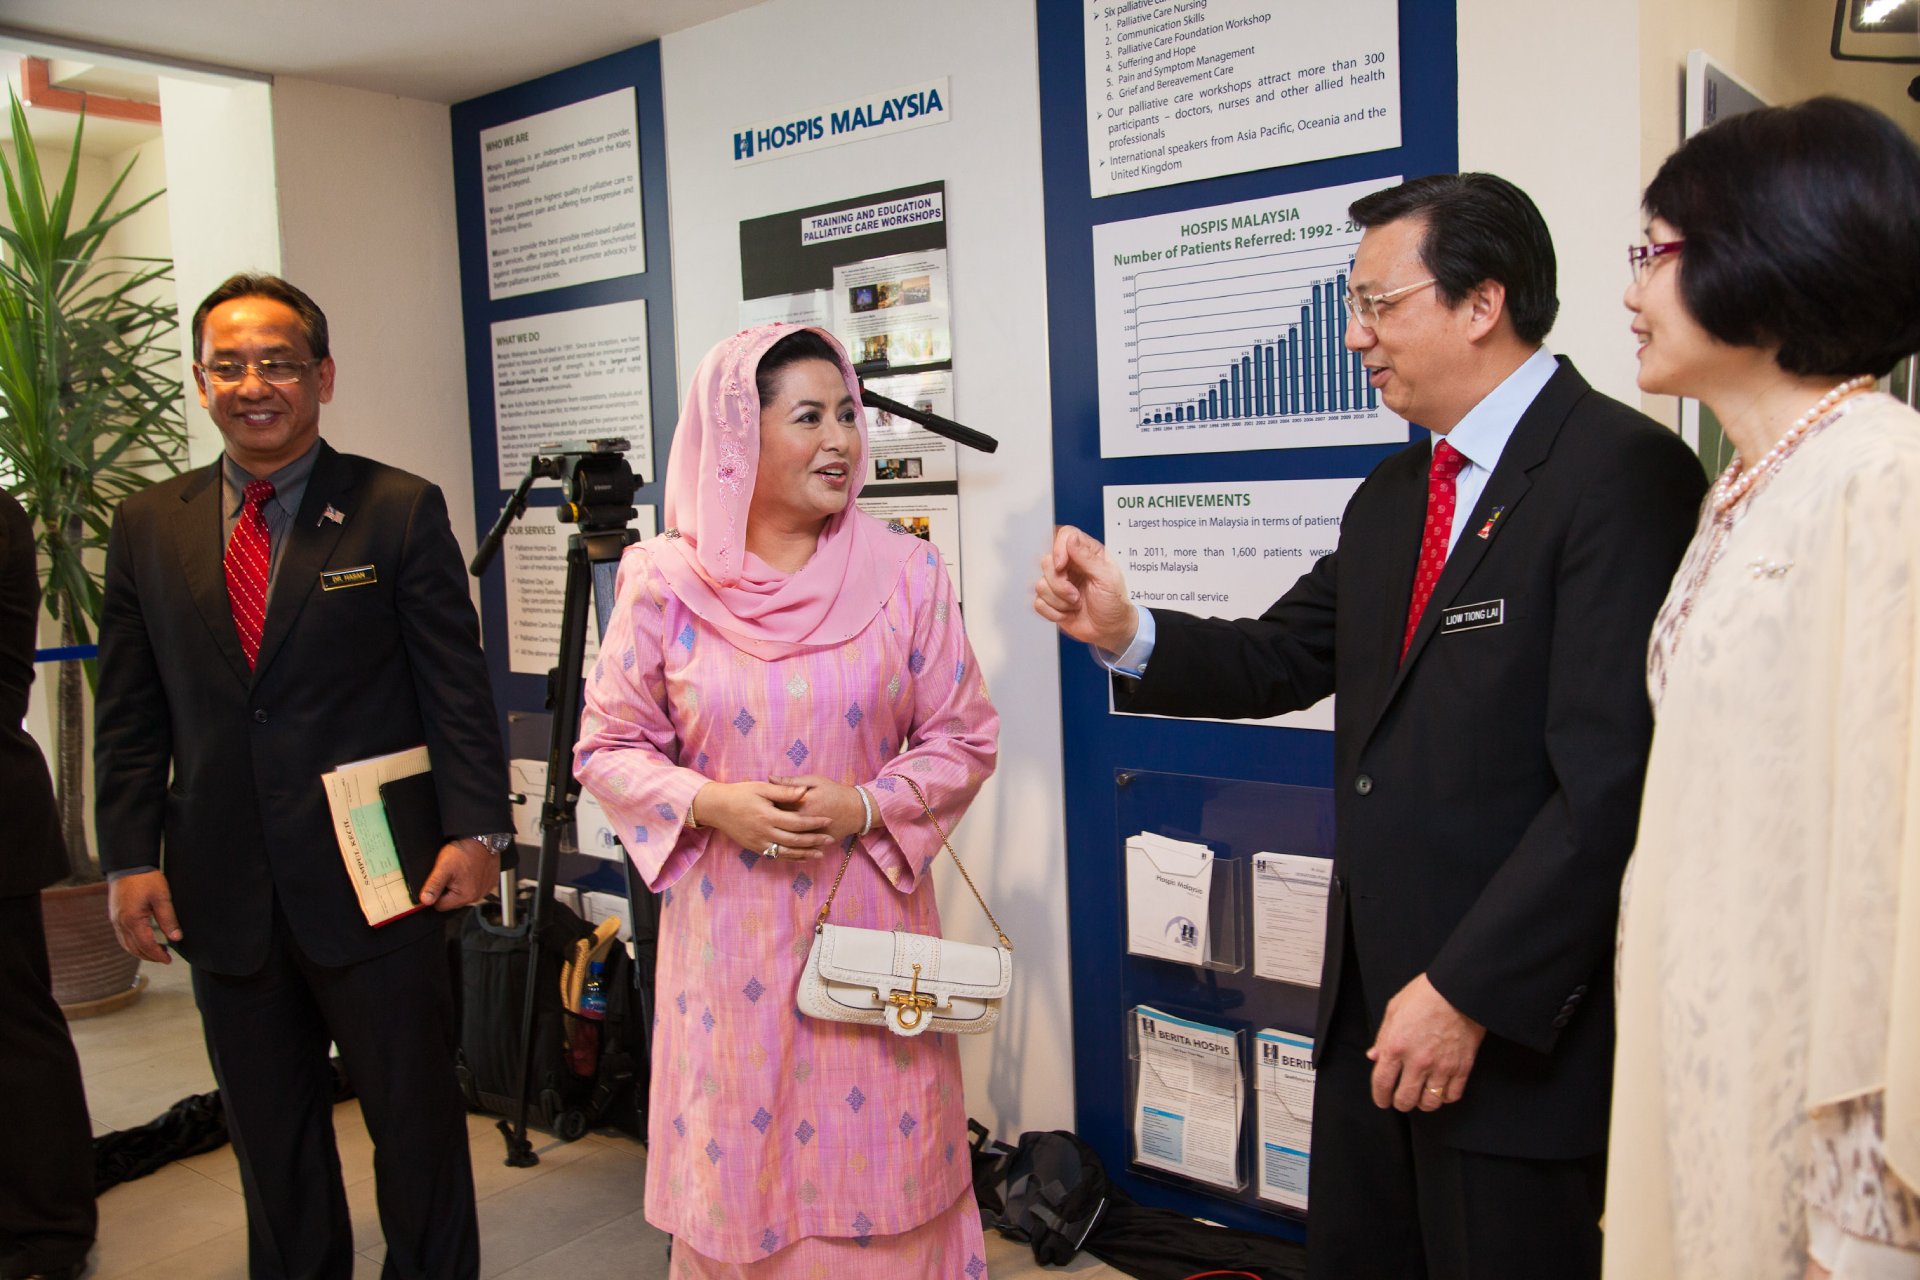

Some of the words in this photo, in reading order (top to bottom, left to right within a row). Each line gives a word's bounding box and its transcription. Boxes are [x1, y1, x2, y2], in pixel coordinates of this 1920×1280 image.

[1104, 7, 1115, 18] Six
[1117, 0, 1153, 16] palliative
[1116, 13, 1152, 28] Palliative
[1153, 7, 1172, 18] Care
[1173, 0, 1206, 13] Nursing
[1116, 19, 1181, 42] Communication
[1183, 12, 1204, 26] Skills
[1117, 41, 1152, 56] Palliative
[1153, 36, 1172, 47] Care
[1174, 24, 1223, 42] Foundation
[1224, 13, 1271, 30] Workshop
[1118, 55, 1153, 70] Suffering
[1155, 48, 1171, 61] and
[1173, 45, 1196, 56] Hope
[1118, 73, 1134, 84] Pain
[1136, 67, 1152, 80] and
[1153, 60, 1194, 77] Symptom
[1196, 45, 1254, 66] Management
[1107, 107, 1123, 118] Our
[1128, 98, 1168, 115] palliative
[1173, 92, 1193, 103] care
[1199, 80, 1251, 98] workshops
[1257, 71, 1291, 86] attract
[1298, 65, 1325, 78] more
[1332, 59, 1356, 71] than
[1364, 51, 1384, 65] 300
[1118, 84, 1138, 98] Grief
[1139, 80, 1154, 93] and
[1156, 70, 1212, 89] Bereavement
[1213, 66, 1233, 76] Care
[1108, 115, 1159, 135] participants
[1174, 104, 1212, 119] doctors,
[1218, 97, 1249, 110] nurses
[1255, 90, 1274, 103] and
[1280, 85, 1308, 98] other
[1314, 76, 1343, 92] allied
[1350, 68, 1384, 85] health
[757, 116, 823, 152] HOSPIS
[830, 88, 943, 135] MALAYSIA
[486, 141, 502, 152] WHO
[504, 136, 514, 147] WE
[516, 132, 529, 144] ARE
[1108, 128, 1165, 150] professionals
[1110, 145, 1165, 165] International
[1167, 139, 1208, 156] speakers
[1210, 135, 1233, 146] from
[1236, 129, 1256, 141] Asia
[1260, 122, 1294, 137] Pacific,
[1297, 115, 1340, 130] Oceania
[1343, 108, 1364, 122] and
[1367, 106, 1386, 118] the
[1110, 166, 1139, 180] United
[1141, 160, 1182, 175] Kingdom
[804, 224, 852, 241] PALLIATIVE
[854, 219, 878, 232] CARE
[881, 207, 941, 227] WORKSHOPS
[811, 213, 853, 228] TRAINING
[856, 208, 874, 220] AND
[877, 198, 931, 216] EDUCATION
[1180, 218, 1228, 237] HOSPIS
[1231, 207, 1300, 229] MALAYSIA
[1114, 250, 1162, 266] Number
[1164, 244, 1178, 258] of
[1180, 240, 1231, 256] Patients
[1234, 228, 1295, 248] Referred:
[1299, 223, 1332, 239] 1992
[1344, 220, 1360, 233] 20
[496, 335, 515, 346] WHAT
[517, 333, 527, 343] WE
[528, 332, 540, 341] DO
[1117, 496, 1144, 508] OUR
[1147, 493, 1250, 508] ACHIEVEMENTS
[509, 526, 523, 535] OUR
[524, 526, 556, 535] SERVICES
[1128, 518, 1160, 529] Largest
[1162, 517, 1196, 528] hospice
[1198, 517, 1207, 526] in
[1209, 516, 1248, 528] Malaysia
[1251, 516, 1260, 526] in
[1262, 517, 1289, 526] terms
[1292, 514, 1302, 525] of
[1129, 547, 1137, 556] In
[1144, 547, 1167, 556] 2011,
[1203, 546, 1224, 556] than
[1232, 547, 1256, 557] 1,600
[1263, 548, 1302, 558] patients
[1309, 549, 1334, 557] were
[1129, 561, 1158, 573] Hospis
[1160, 561, 1198, 573] Malaysia
[1130, 590, 1164, 600] 24-hour
[1180, 591, 1195, 600] call
[1197, 592, 1228, 602] service
[1446, 613, 1463, 625] LIOW
[1464, 609, 1485, 622] TIONG
[1486, 607, 1498, 618] LAI
[1158, 1030, 1192, 1046] BERITA
[1193, 1039, 1230, 1055] HOSPIS
[1282, 1056, 1314, 1071] BERIT
